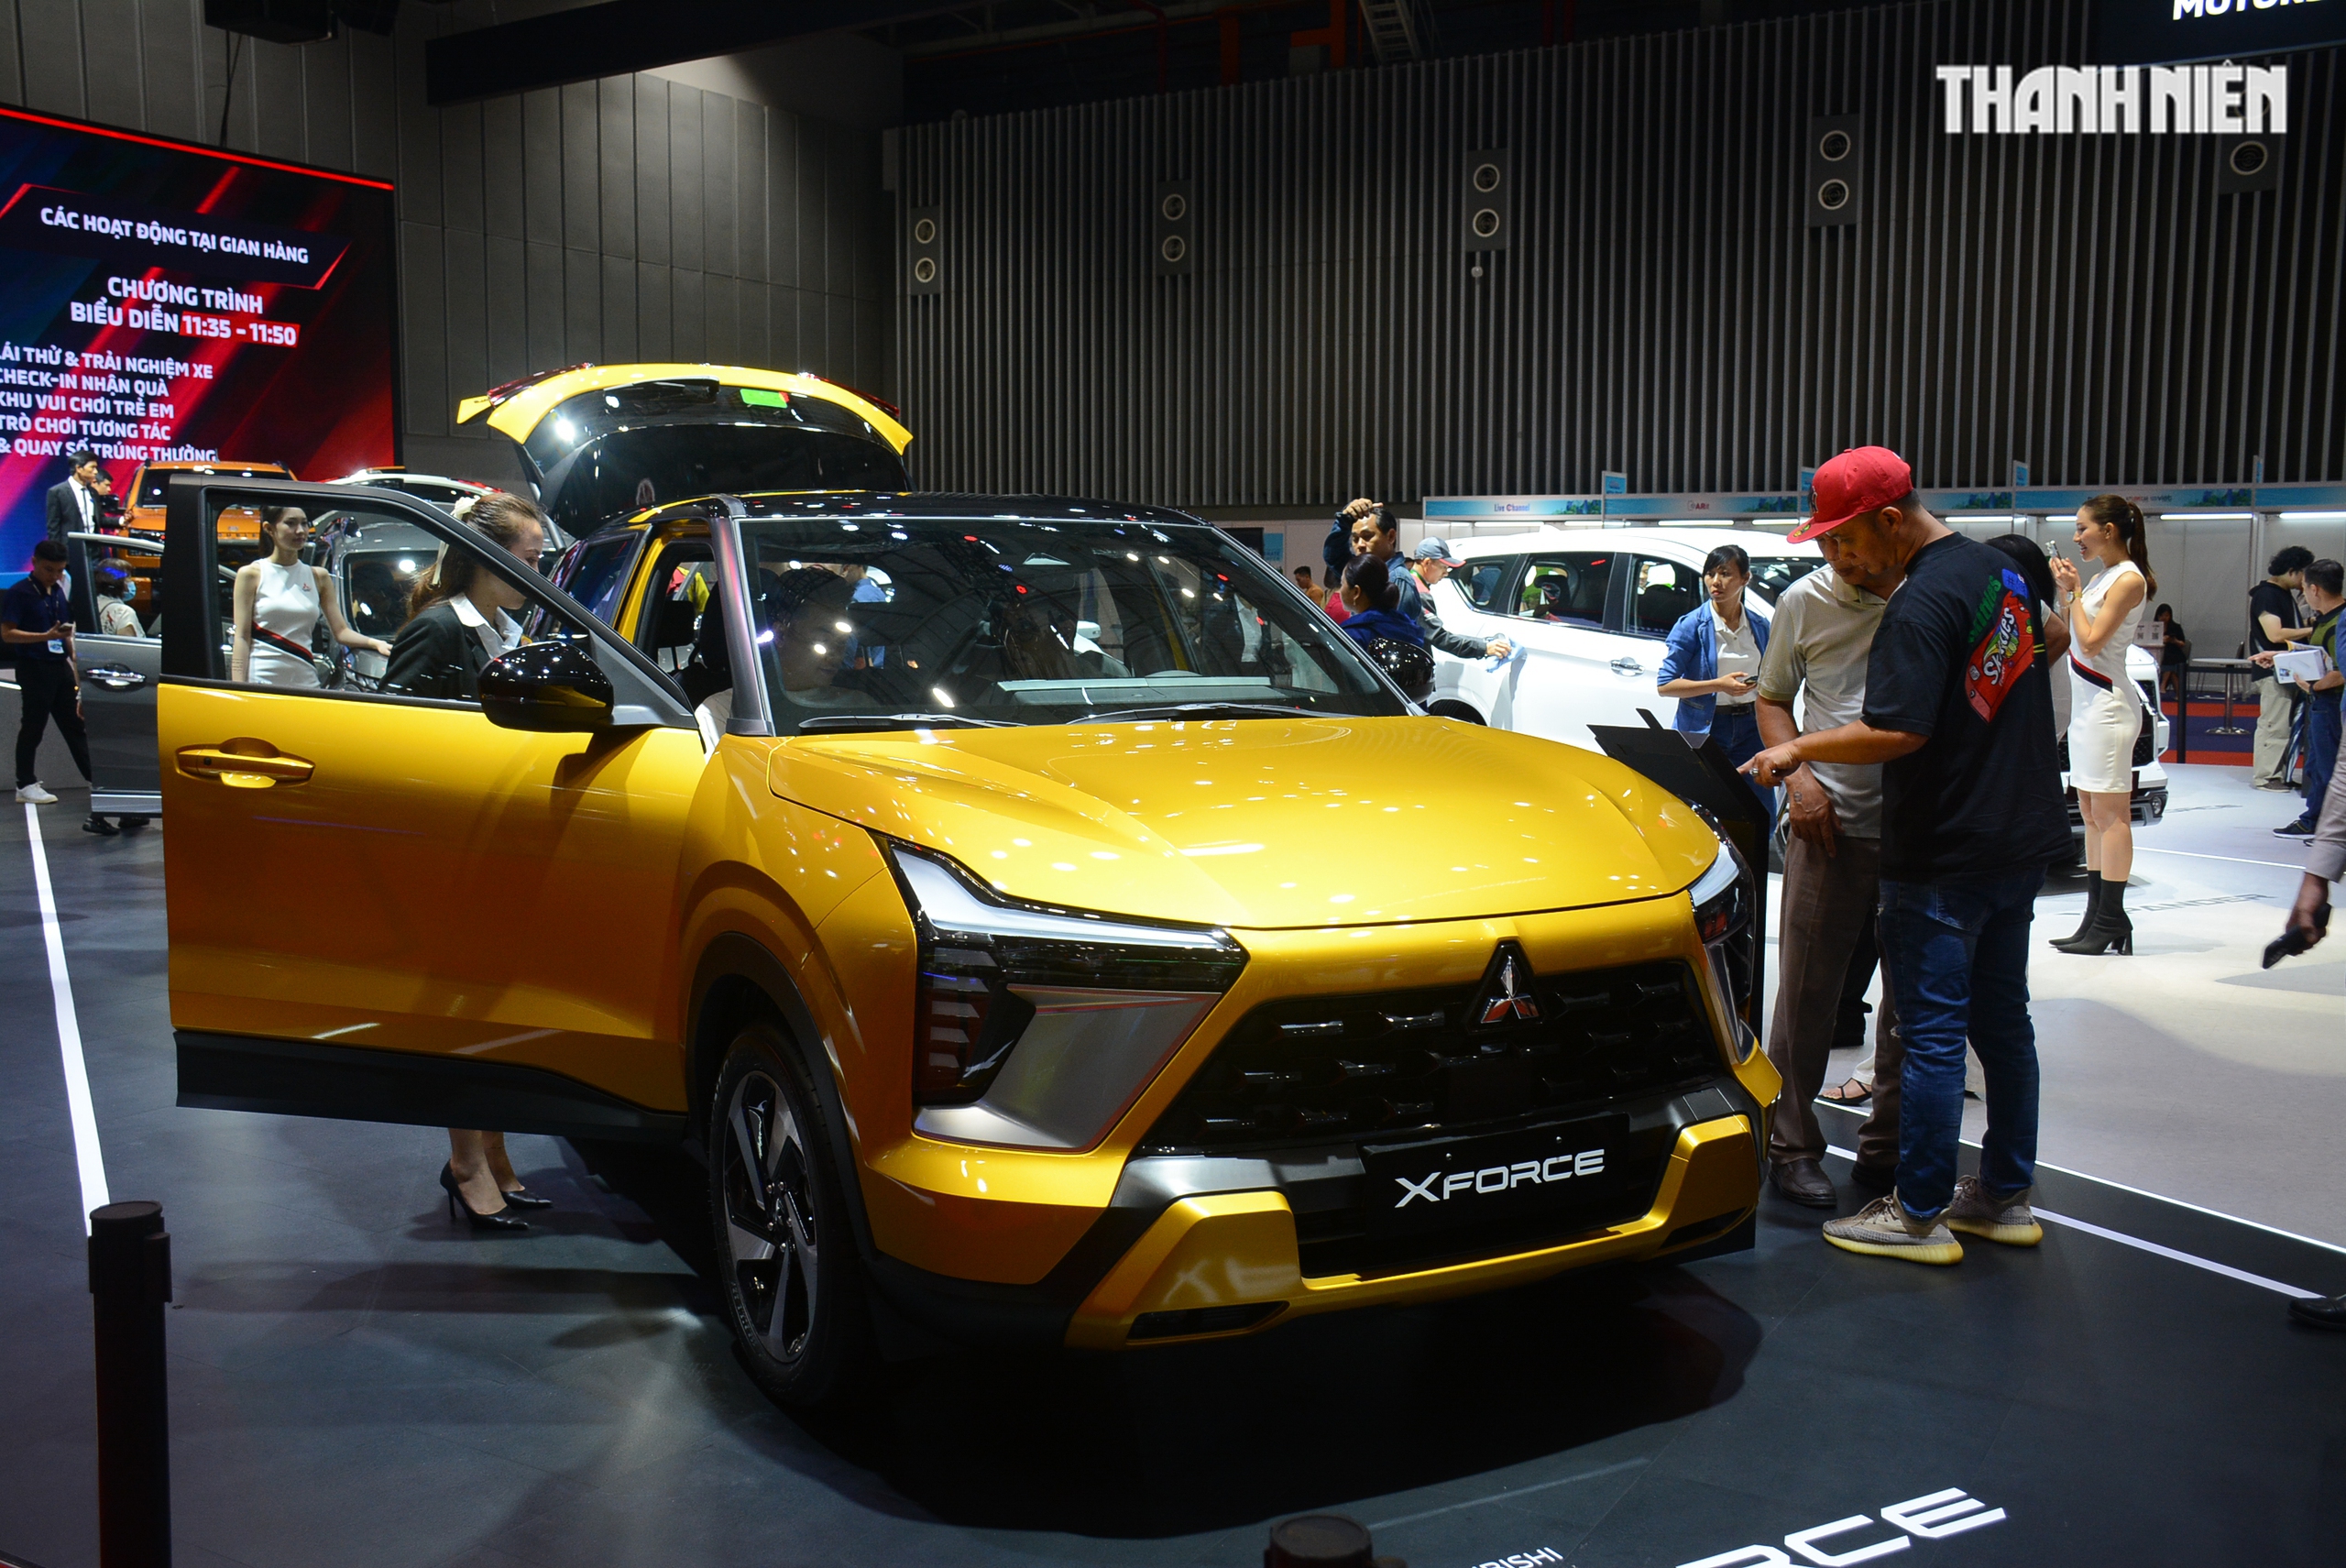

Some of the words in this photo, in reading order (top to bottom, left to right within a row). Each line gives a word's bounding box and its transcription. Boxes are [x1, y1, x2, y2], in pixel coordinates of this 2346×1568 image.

[40, 205, 79, 229] CÁC
[83, 214, 133, 239] HOẠT
[137, 221, 187, 246] ĐỘNG
[189, 230, 216, 252] TẠI
[220, 236, 260, 258] GIAN
[264, 240, 309, 264] HÀNG
[107, 277, 198, 306] CHƯƠNG
[201, 287, 263, 313] TRÌNH
[71, 296, 123, 326] BIỂU
[128, 303, 179, 333] DIỄN
[182, 315, 231, 338] 11:35
[249, 323, 296, 345] 11:50
[23, 345, 62, 366] THỬ
[64, 351, 80, 367] &
[81, 350, 122, 370] TRẢI
[126, 356, 189, 379] NGHIỆM
[192, 363, 214, 379] XE
[82, 374, 130, 396] NHẬN
[134, 378, 170, 397] QUÀ
[35, 394, 66, 411] VUI
[69, 396, 111, 414] CHƠI
[113, 397, 146, 417] TRẺ
[148, 402, 174, 419] EM
[34, 416, 77, 435] CHƠI
[79, 419, 138, 439] TƯƠNG
[140, 422, 171, 441] TÁC
[14, 438, 62, 457] QUAY
[90, 440, 148, 461] TRÚNG
[150, 444, 216, 462] THƯỞNG
[1394, 1149, 1606, 1209] XFORCE
